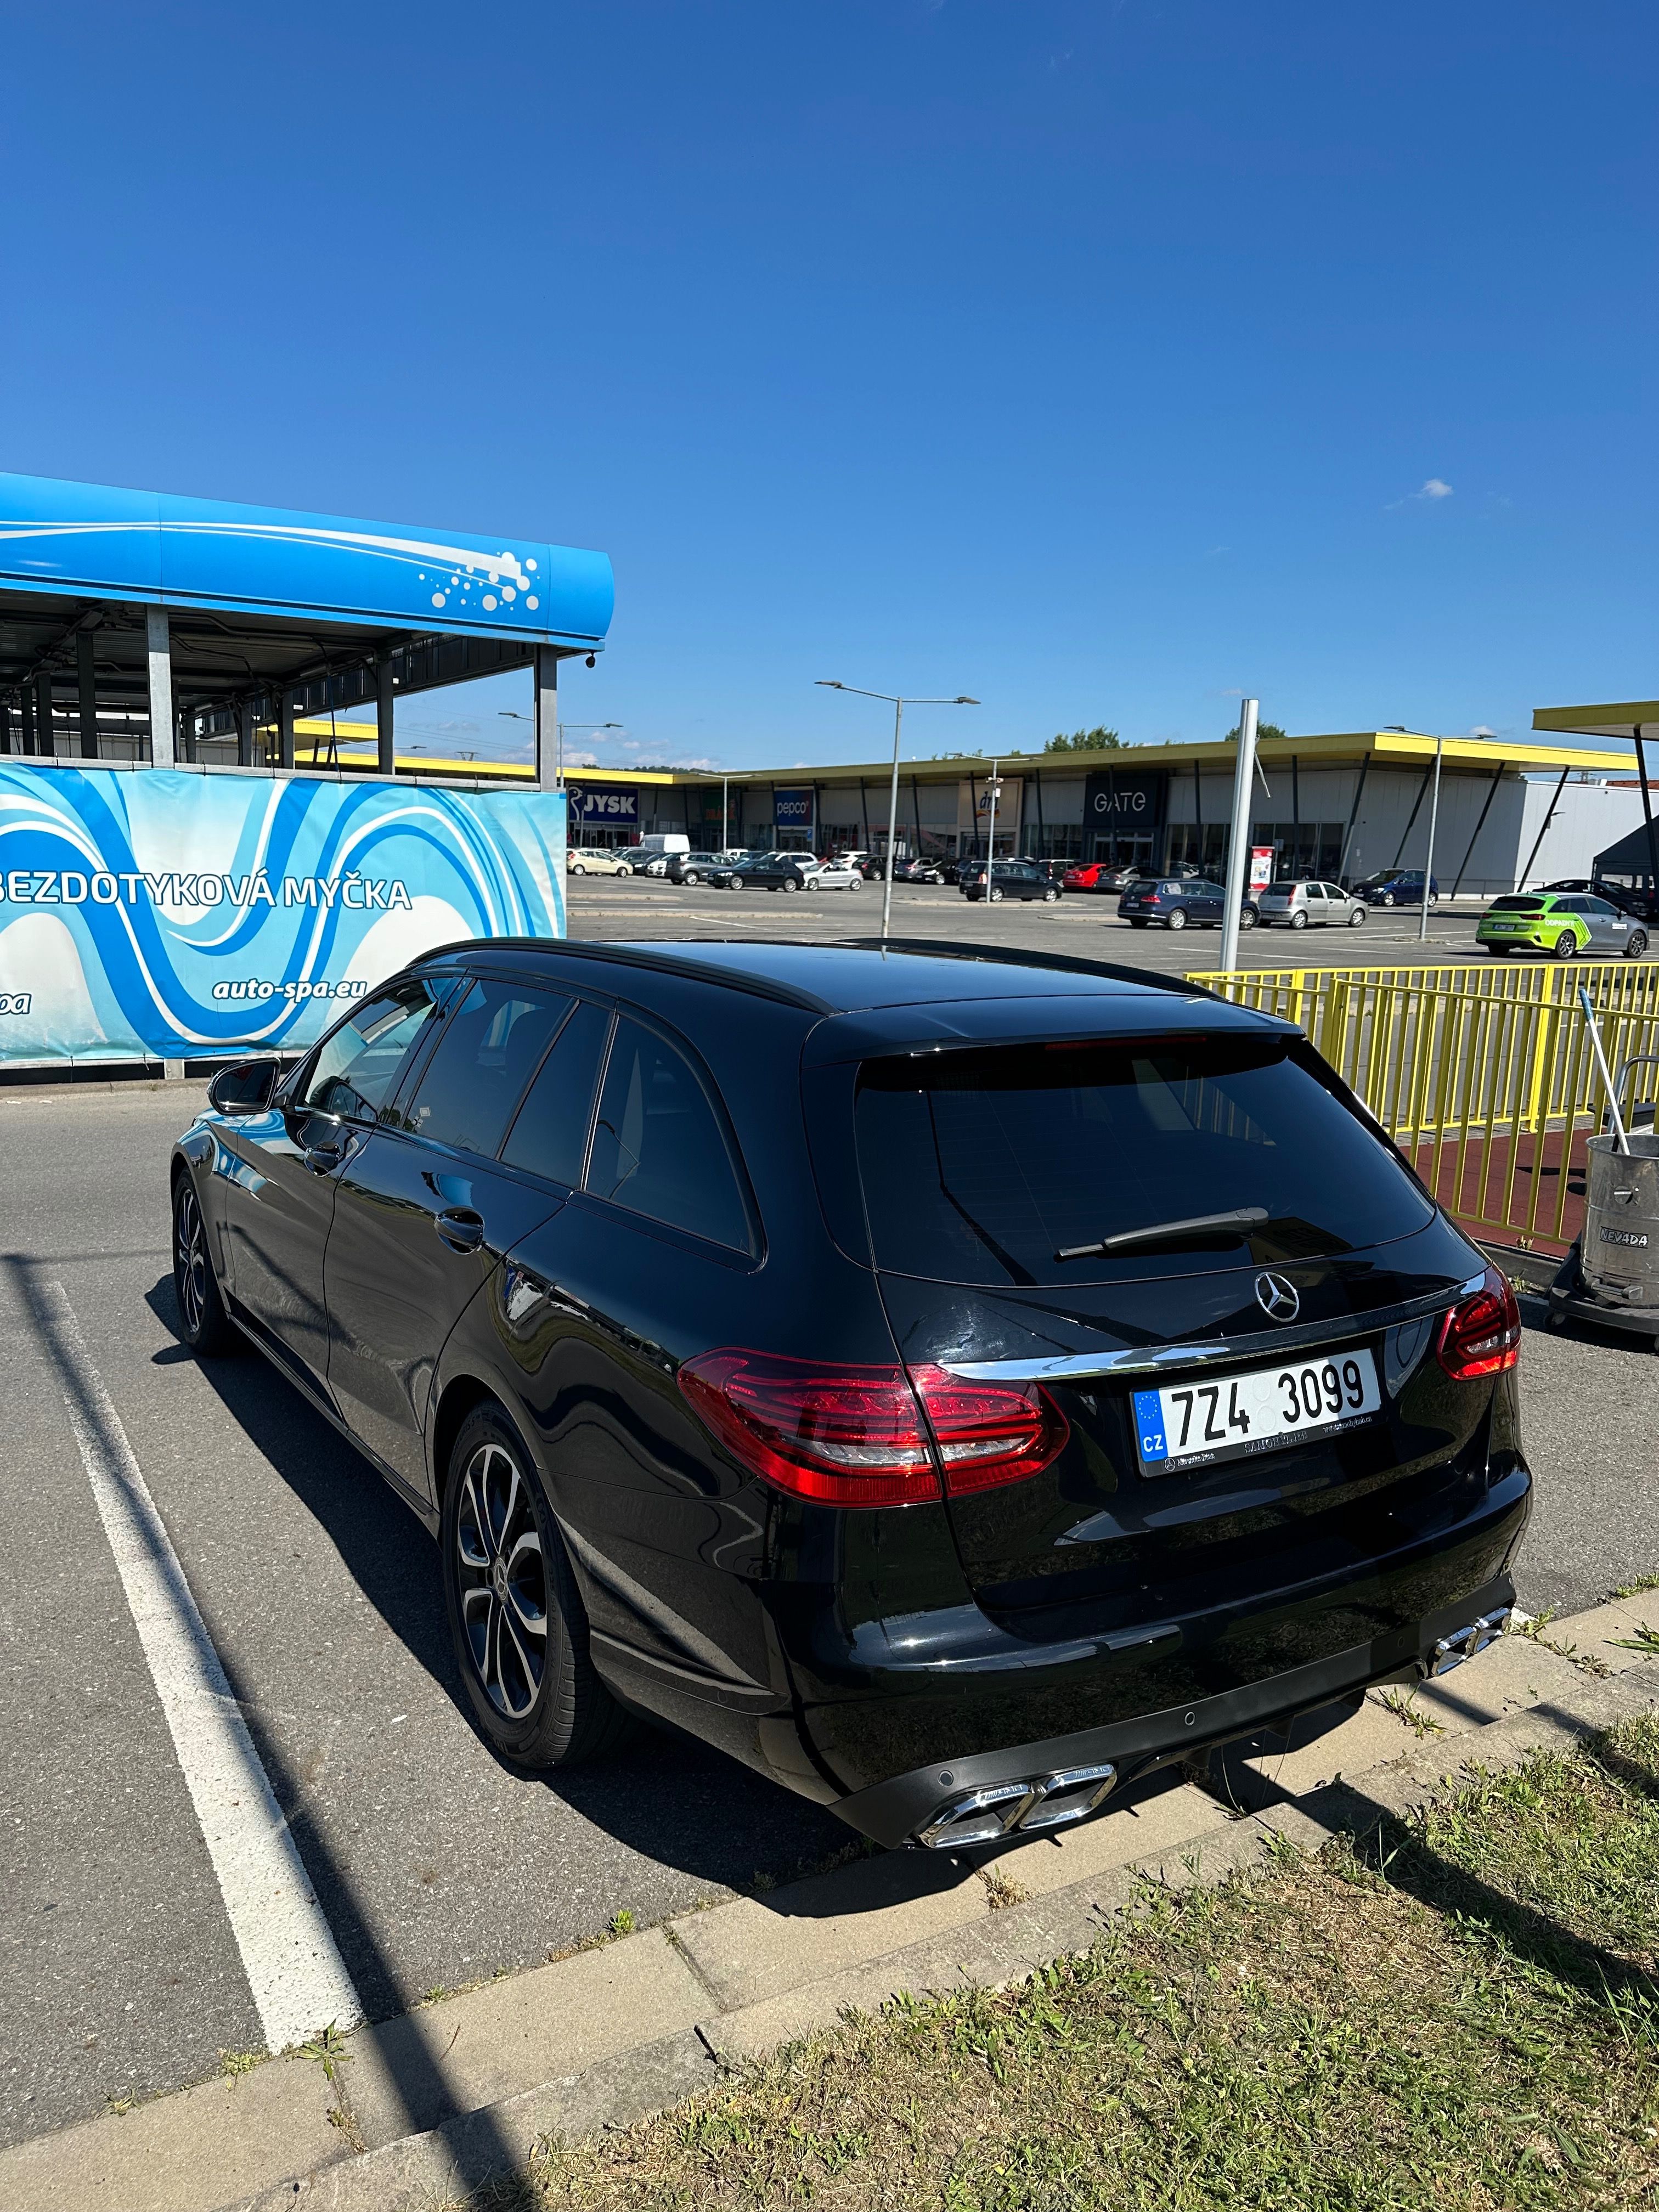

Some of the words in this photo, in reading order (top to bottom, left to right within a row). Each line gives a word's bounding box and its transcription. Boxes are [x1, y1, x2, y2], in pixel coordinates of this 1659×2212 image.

[584, 794, 635, 814] JYSK
[777, 802, 806, 816] pepco
[1094, 792, 1146, 812] GATE
[0, 867, 276, 906] EZDOTYKOVÁ
[283, 869, 413, 910] MYČKA
[212, 978, 367, 1003] auto-spa.eu
[1600, 1228, 1648, 1247] NEVADA
[1171, 1382, 1250, 1447] 7Z4
[1278, 1360, 1364, 1423] 3099
[1143, 1434, 1164, 1453] CZ
